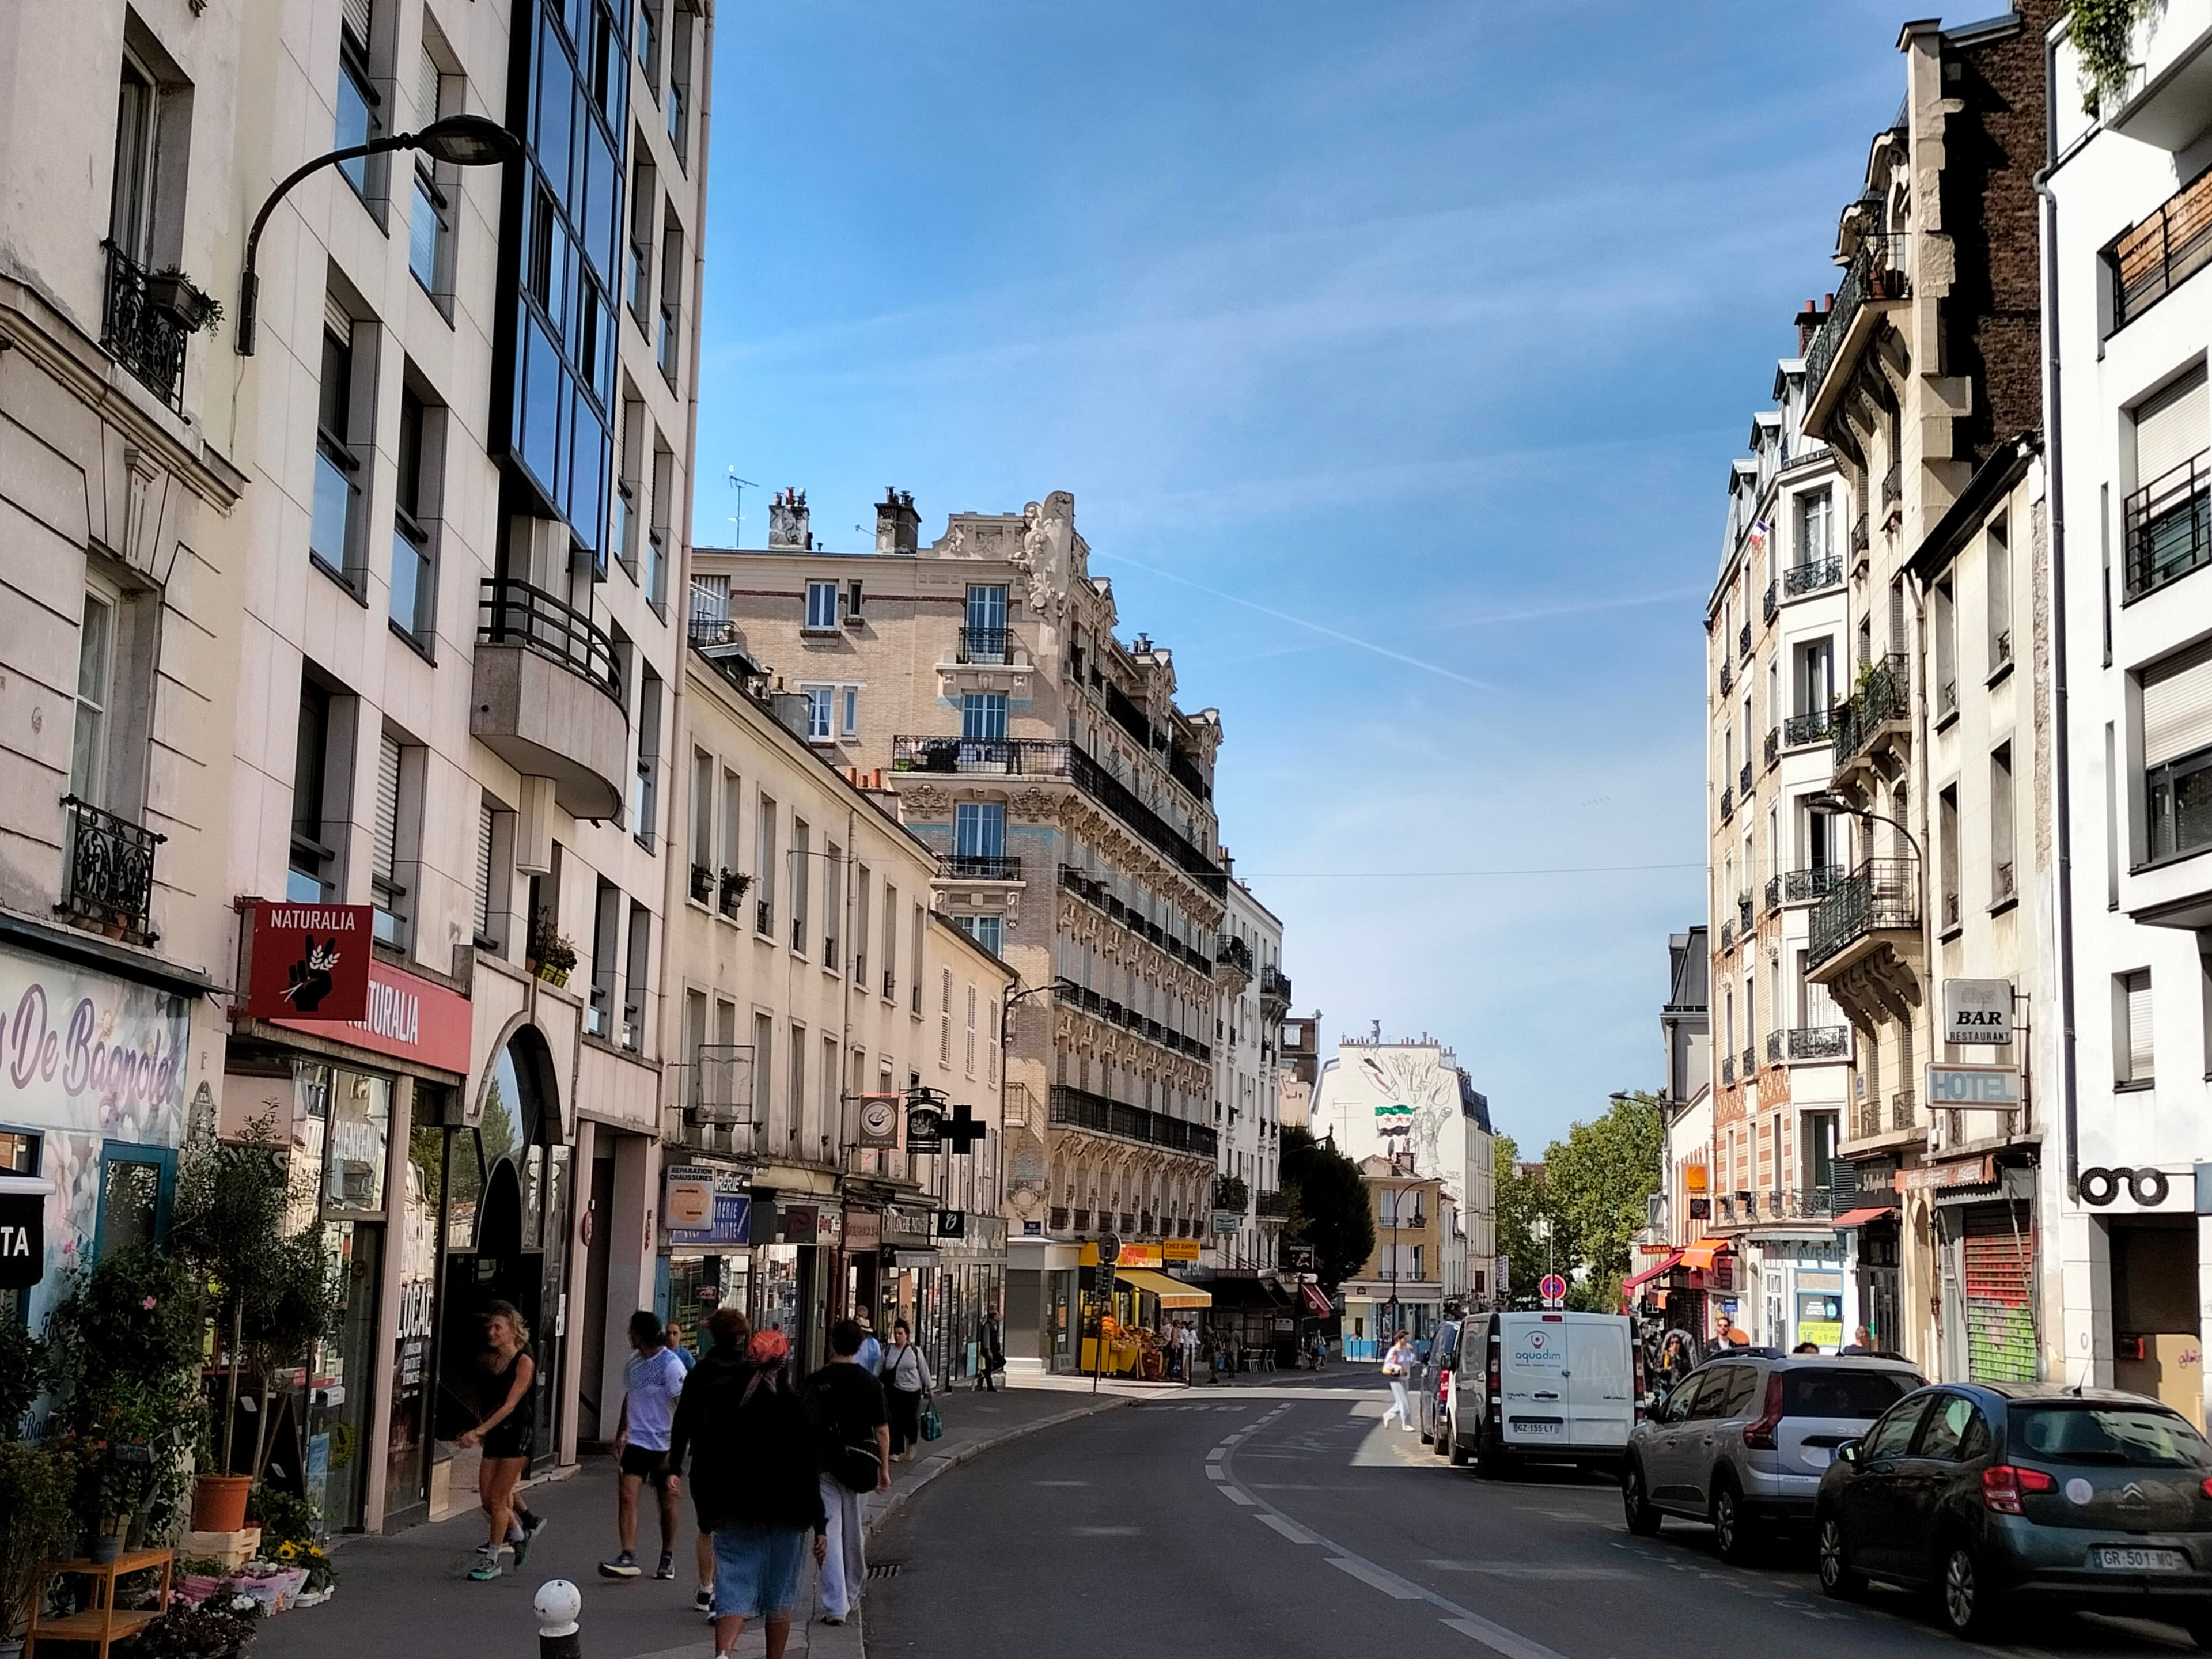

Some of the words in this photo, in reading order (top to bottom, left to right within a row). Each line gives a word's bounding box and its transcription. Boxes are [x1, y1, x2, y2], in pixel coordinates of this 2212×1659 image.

[271, 909, 355, 931] NATURALIA
[347, 980, 419, 1046] TURALIA
[1956, 1011, 2002, 1025] BAR
[1950, 1031, 2010, 1041] RESTAURANT
[10, 983, 59, 1089] De
[62, 998, 180, 1129] Bagnolet
[1932, 1072, 2018, 1101] HOTEL
[396, 1282, 432, 1338] LOCAL
[1515, 1349, 1561, 1363] aquadim
